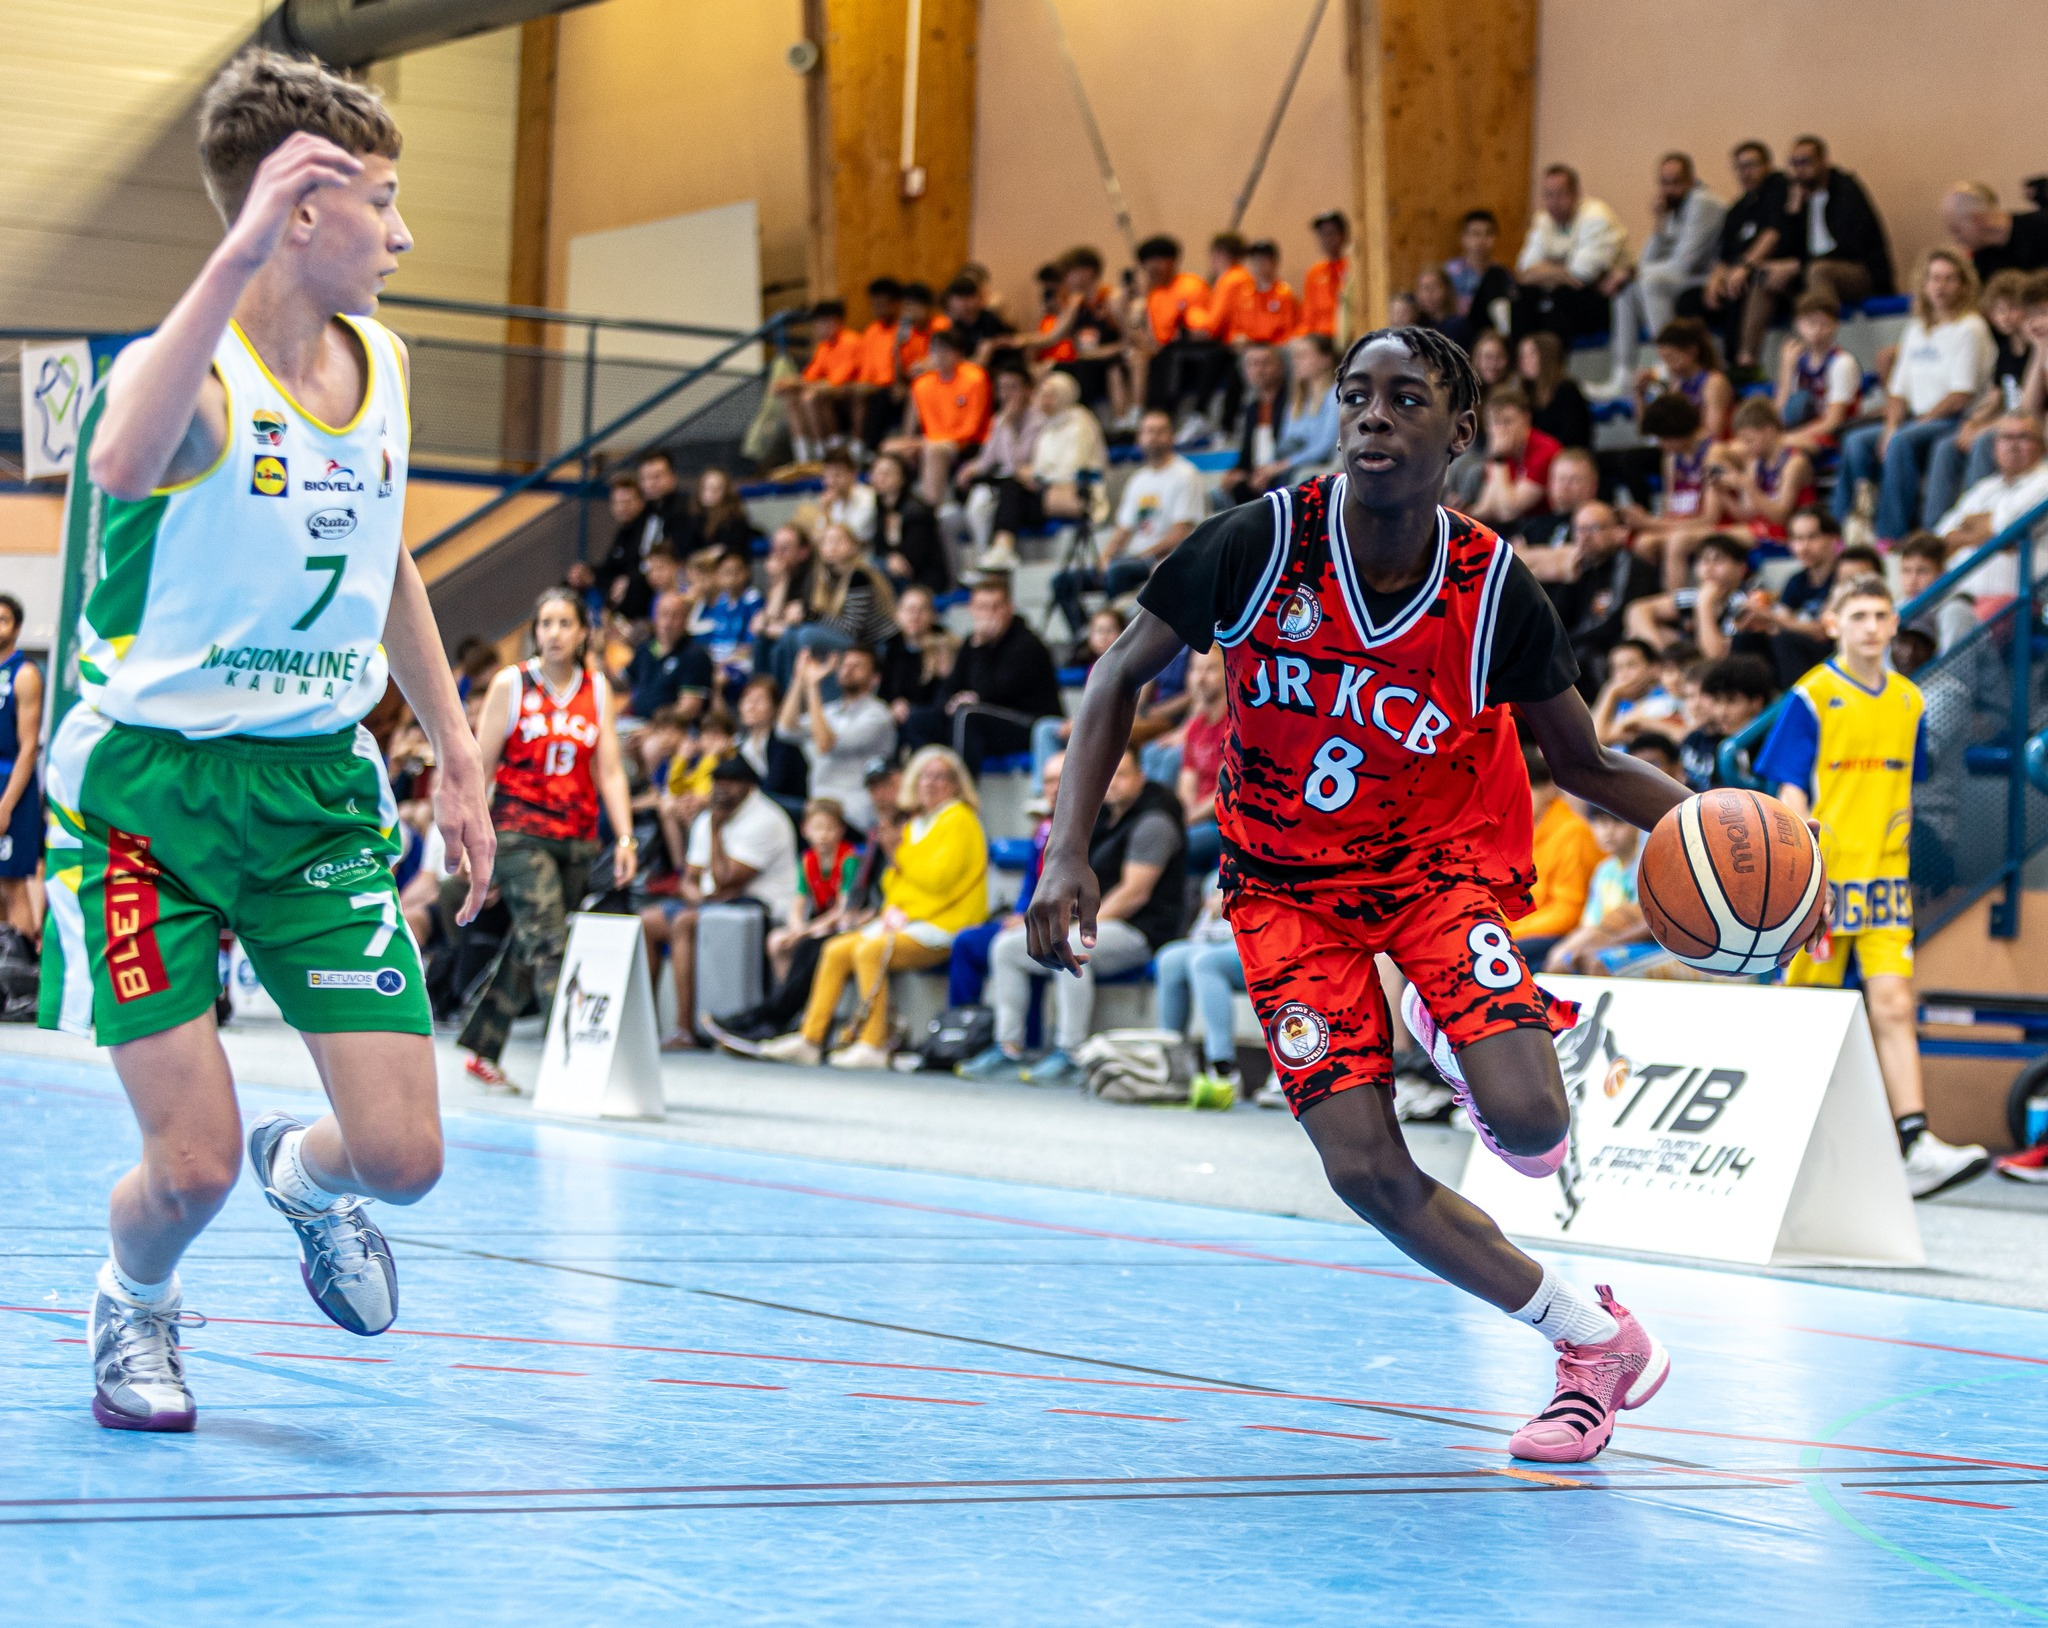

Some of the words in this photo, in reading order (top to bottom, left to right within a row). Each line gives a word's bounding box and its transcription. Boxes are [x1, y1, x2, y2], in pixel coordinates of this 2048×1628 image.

[304, 481, 364, 492] BIOVELA
[290, 554, 349, 631] 7
[225, 670, 334, 700] KAUNA
[1250, 655, 1316, 709] JR
[1329, 662, 1451, 755] KCB
[543, 740, 577, 776] 13
[1303, 734, 1366, 813] 8
[349, 890, 398, 957] 7
[1467, 922, 1523, 989] 8
[1309, 1012, 1325, 1031] COURT
[1612, 1064, 1748, 1133] TIB
[1689, 1144, 1756, 1180] U14
